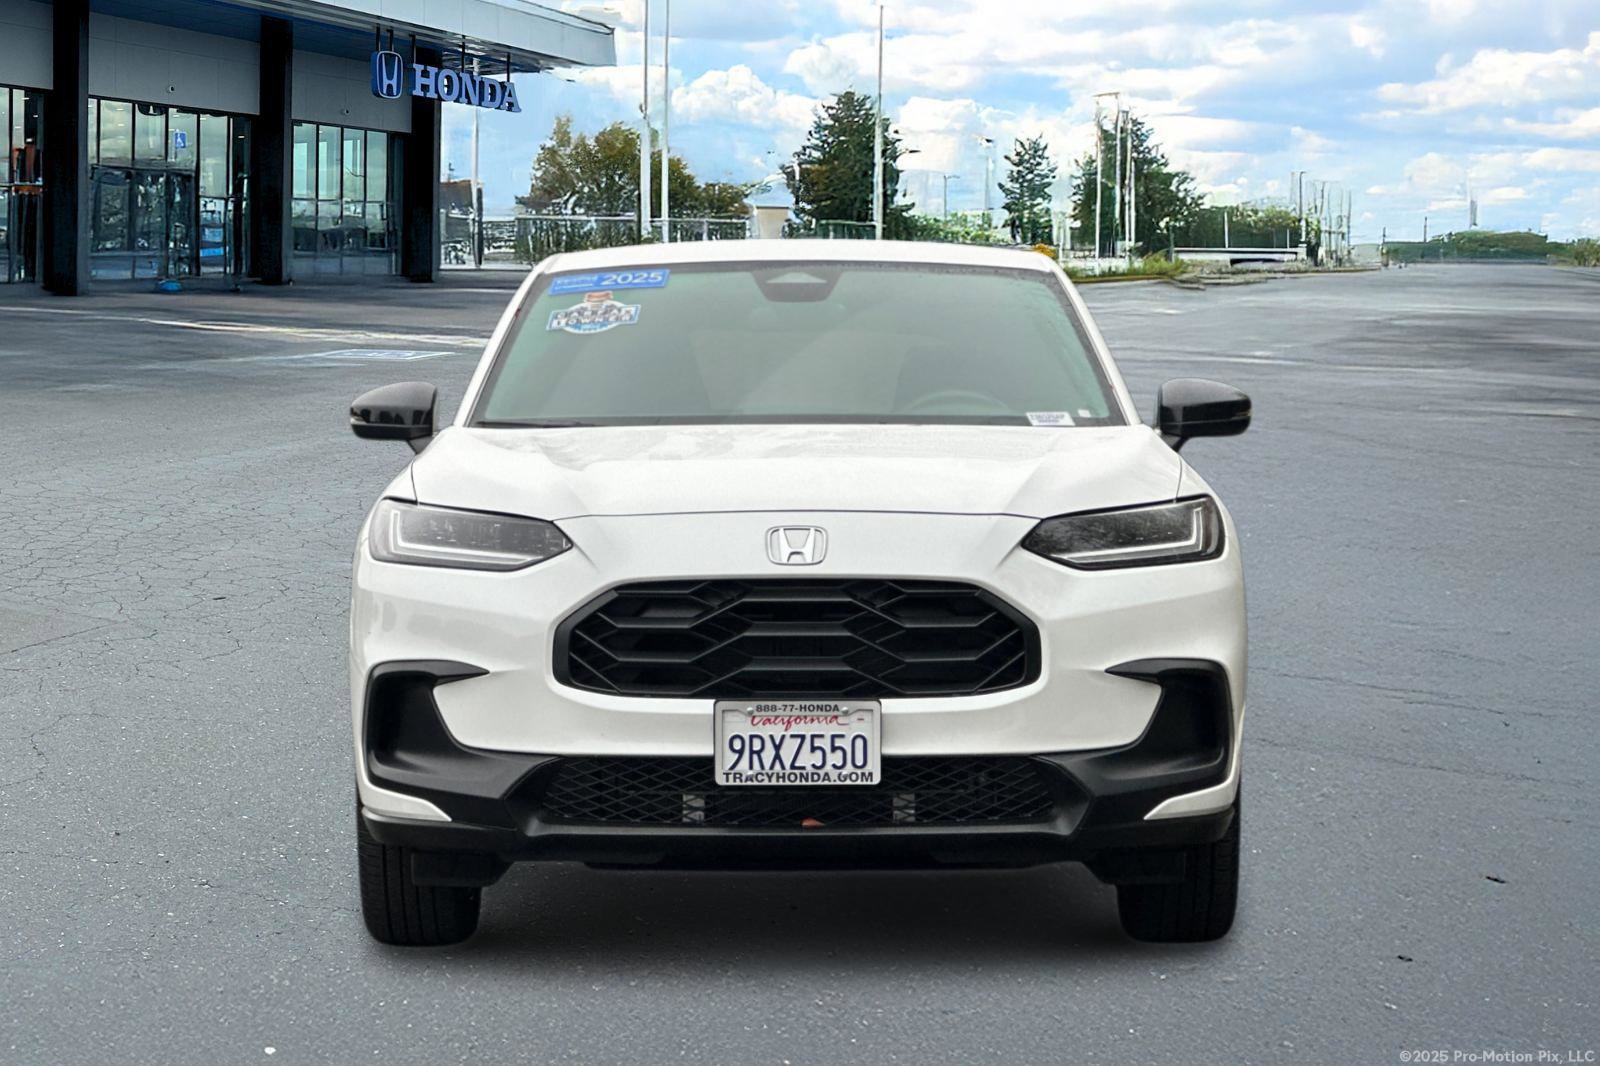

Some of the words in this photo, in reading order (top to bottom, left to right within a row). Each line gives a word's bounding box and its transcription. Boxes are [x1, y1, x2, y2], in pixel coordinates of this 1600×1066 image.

[412, 63, 521, 113] HONDA
[600, 269, 663, 286] 2025
[755, 703, 840, 713] 888-77-HONDA
[727, 733, 869, 771] 9RXZ550
[722, 771, 874, 784] TRACYHONDA.COM
